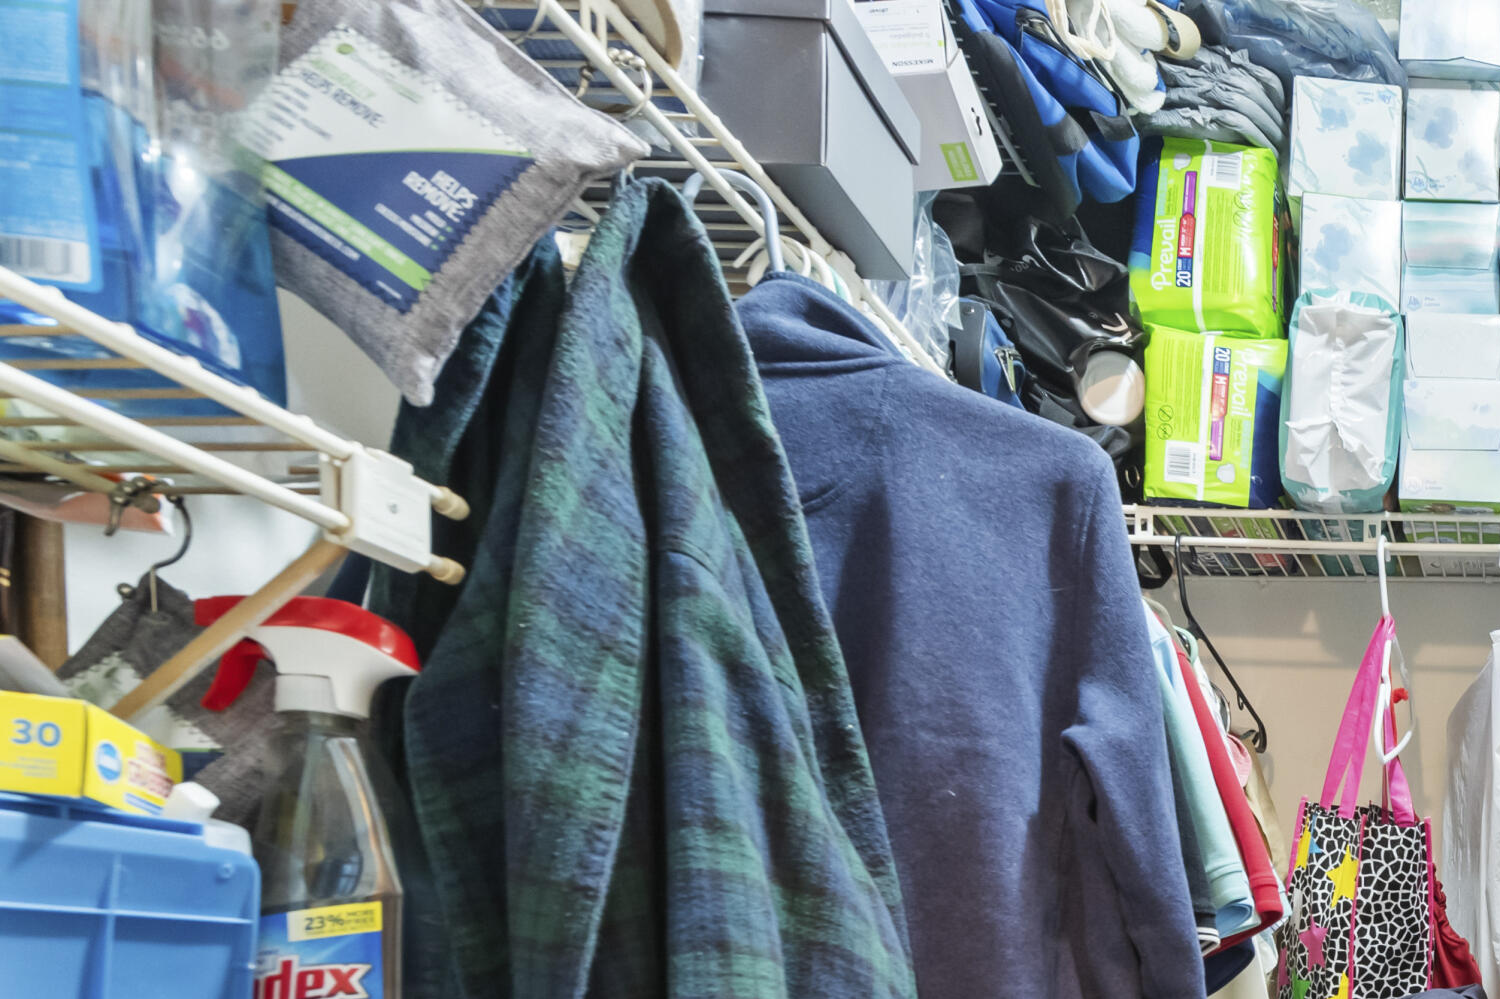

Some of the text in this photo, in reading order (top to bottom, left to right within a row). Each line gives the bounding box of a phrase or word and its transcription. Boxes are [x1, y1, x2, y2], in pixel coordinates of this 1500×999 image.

[1150, 218, 1177, 291] Prevail
[1176, 270, 1192, 287] 20
[1215, 347, 1230, 362] 20
[1231, 348, 1259, 417] Prevail
[10, 718, 61, 747] 30
[305, 916, 345, 931] 23%
